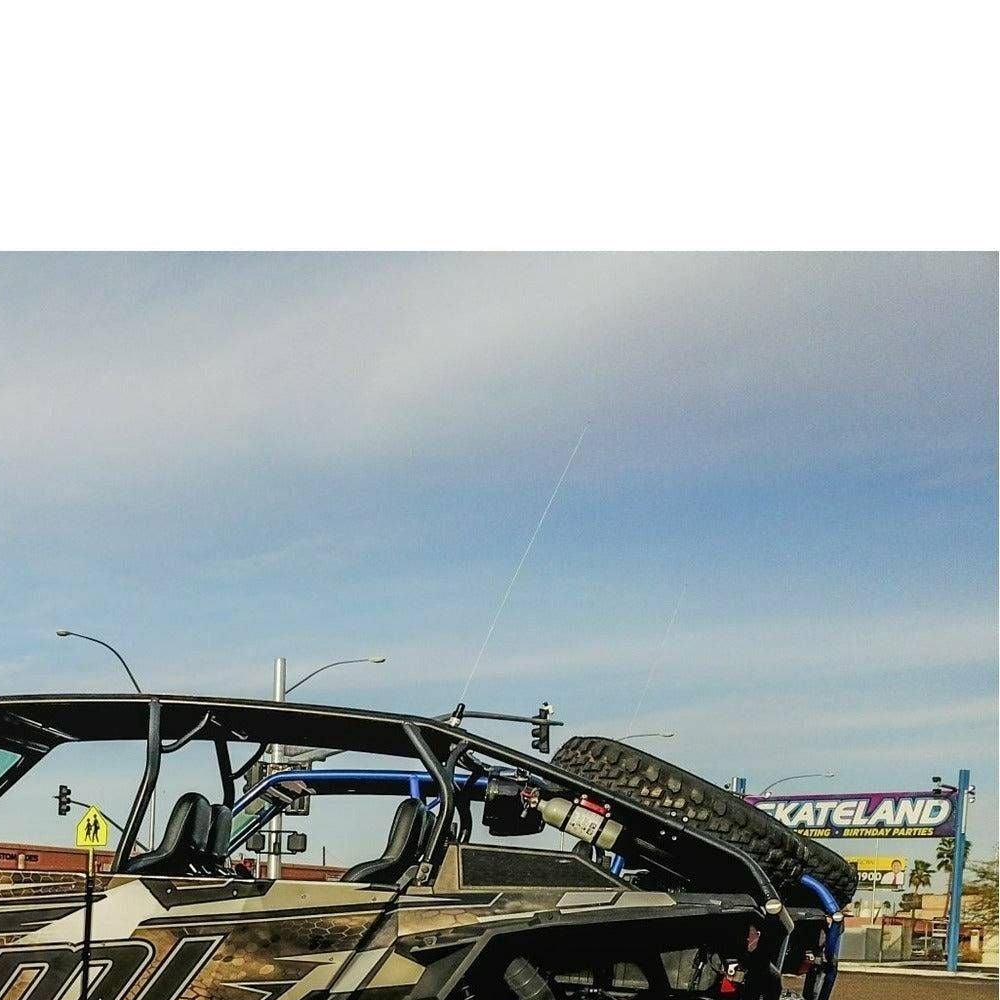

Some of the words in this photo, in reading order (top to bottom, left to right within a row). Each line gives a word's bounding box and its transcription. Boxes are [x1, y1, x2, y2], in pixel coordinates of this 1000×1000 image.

[794, 828, 831, 837] KATING
[843, 828, 891, 837] BIRTHDAY
[892, 827, 934, 836] PARTIES
[857, 871, 882, 882] 1900
